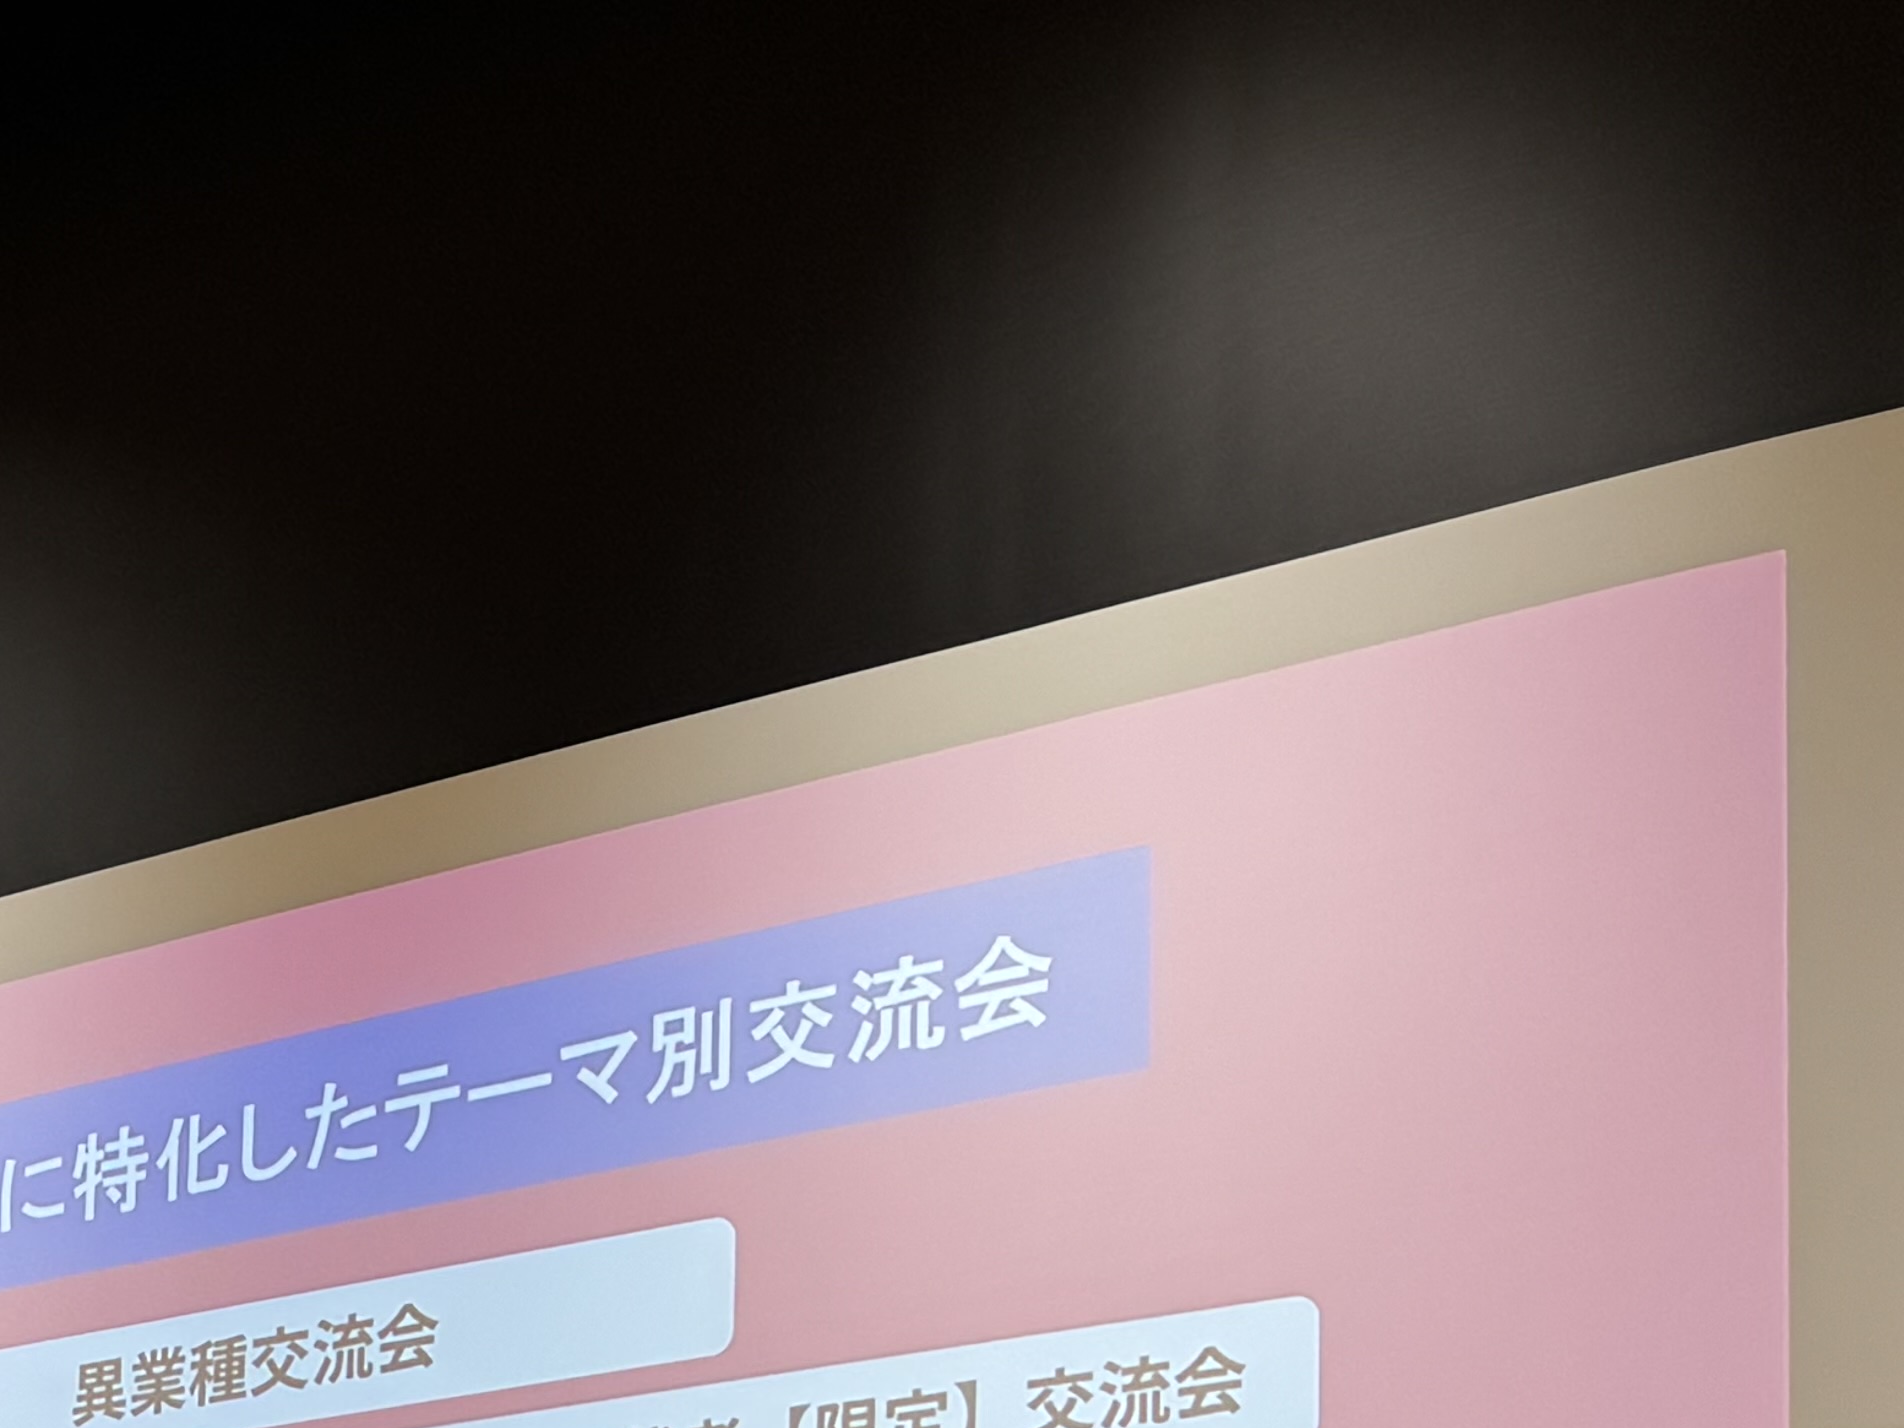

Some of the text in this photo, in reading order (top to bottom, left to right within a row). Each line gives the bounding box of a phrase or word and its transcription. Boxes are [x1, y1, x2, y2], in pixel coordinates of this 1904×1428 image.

[71, 1302, 440, 1427] 異業種交流会
